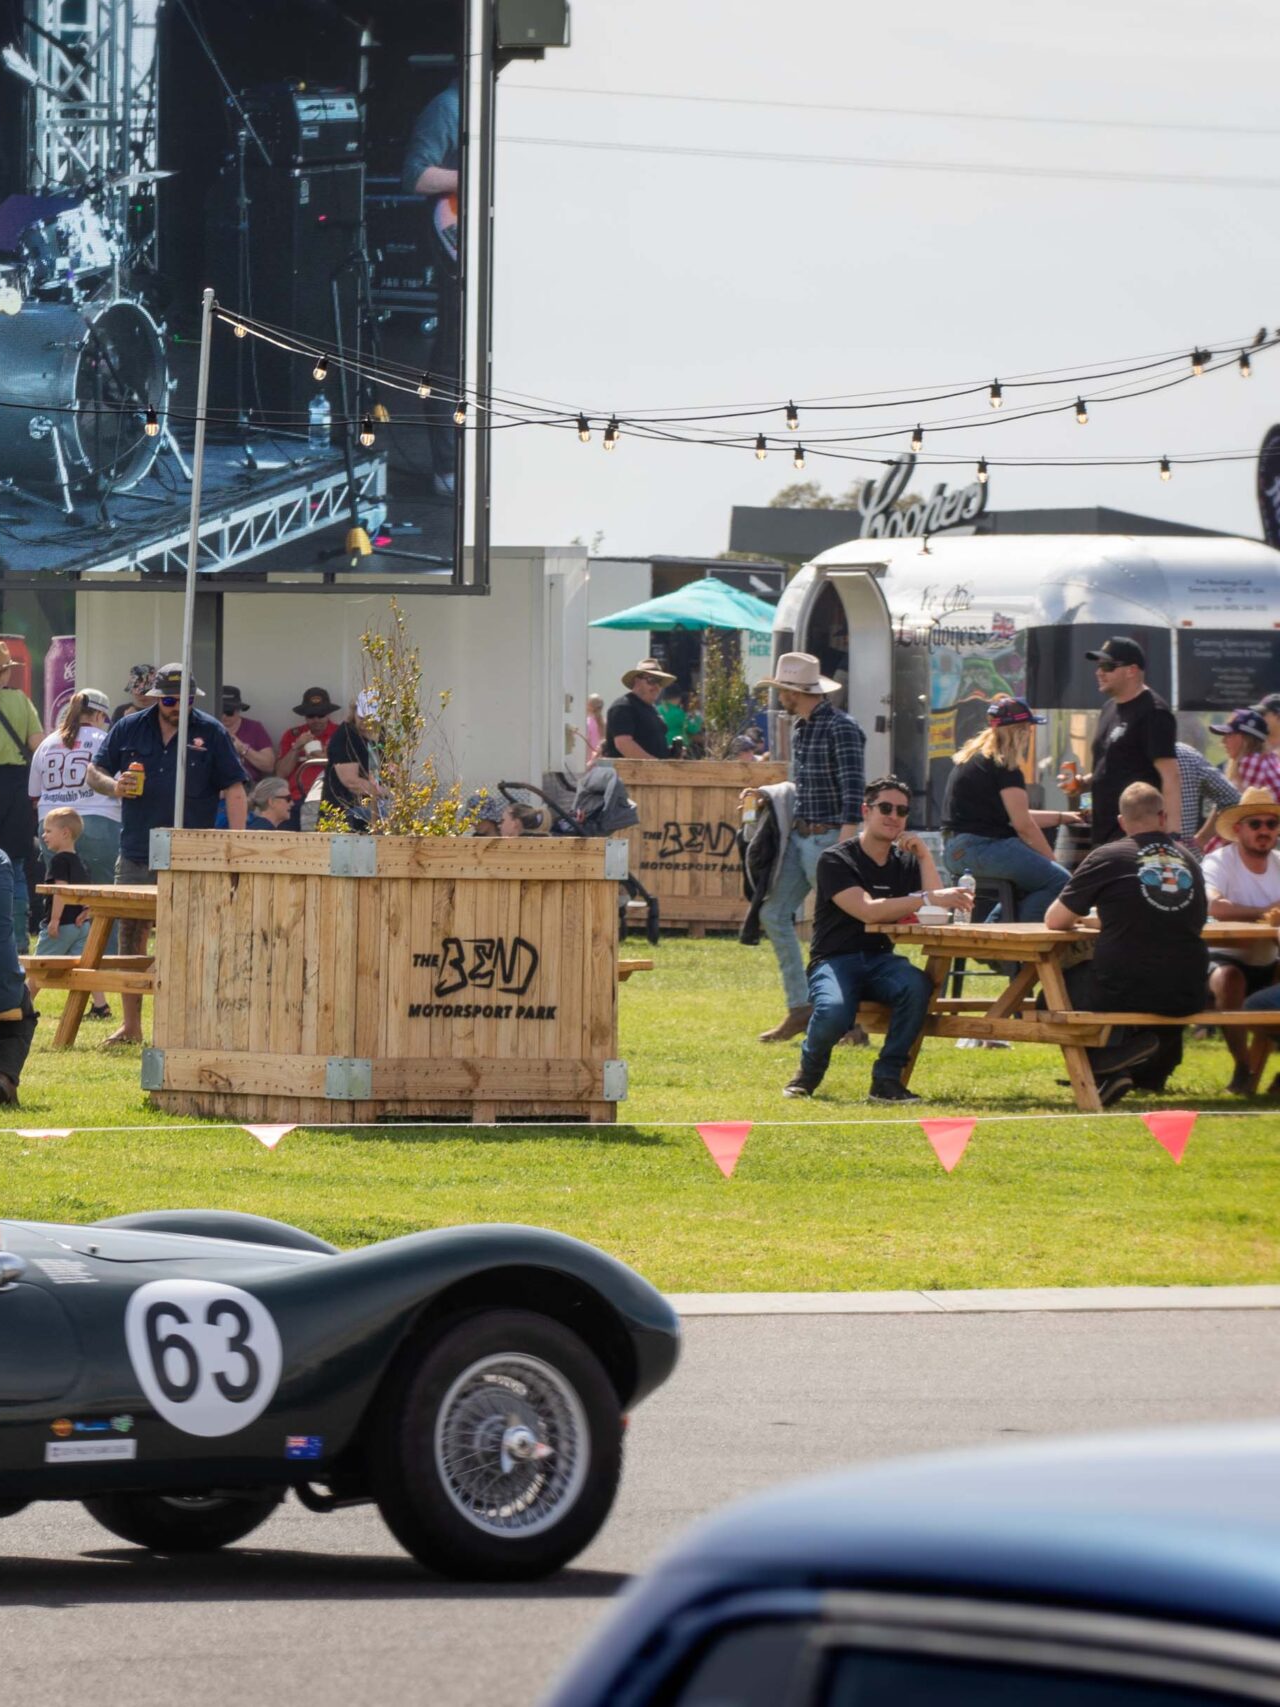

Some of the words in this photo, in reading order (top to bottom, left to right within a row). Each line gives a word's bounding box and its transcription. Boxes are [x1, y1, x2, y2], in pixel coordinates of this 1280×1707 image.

[41, 750, 92, 791] 86
[643, 832, 662, 841] THE
[659, 821, 737, 858] BEND
[639, 861, 718, 872] MOTORSPORT
[720, 863, 743, 873] PAR
[412, 953, 440, 967] THE
[435, 937, 539, 998] BEND
[408, 1004, 513, 1019] MOTORSPORT
[515, 1006, 557, 1020] PARK
[145, 1299, 260, 1404] 63
